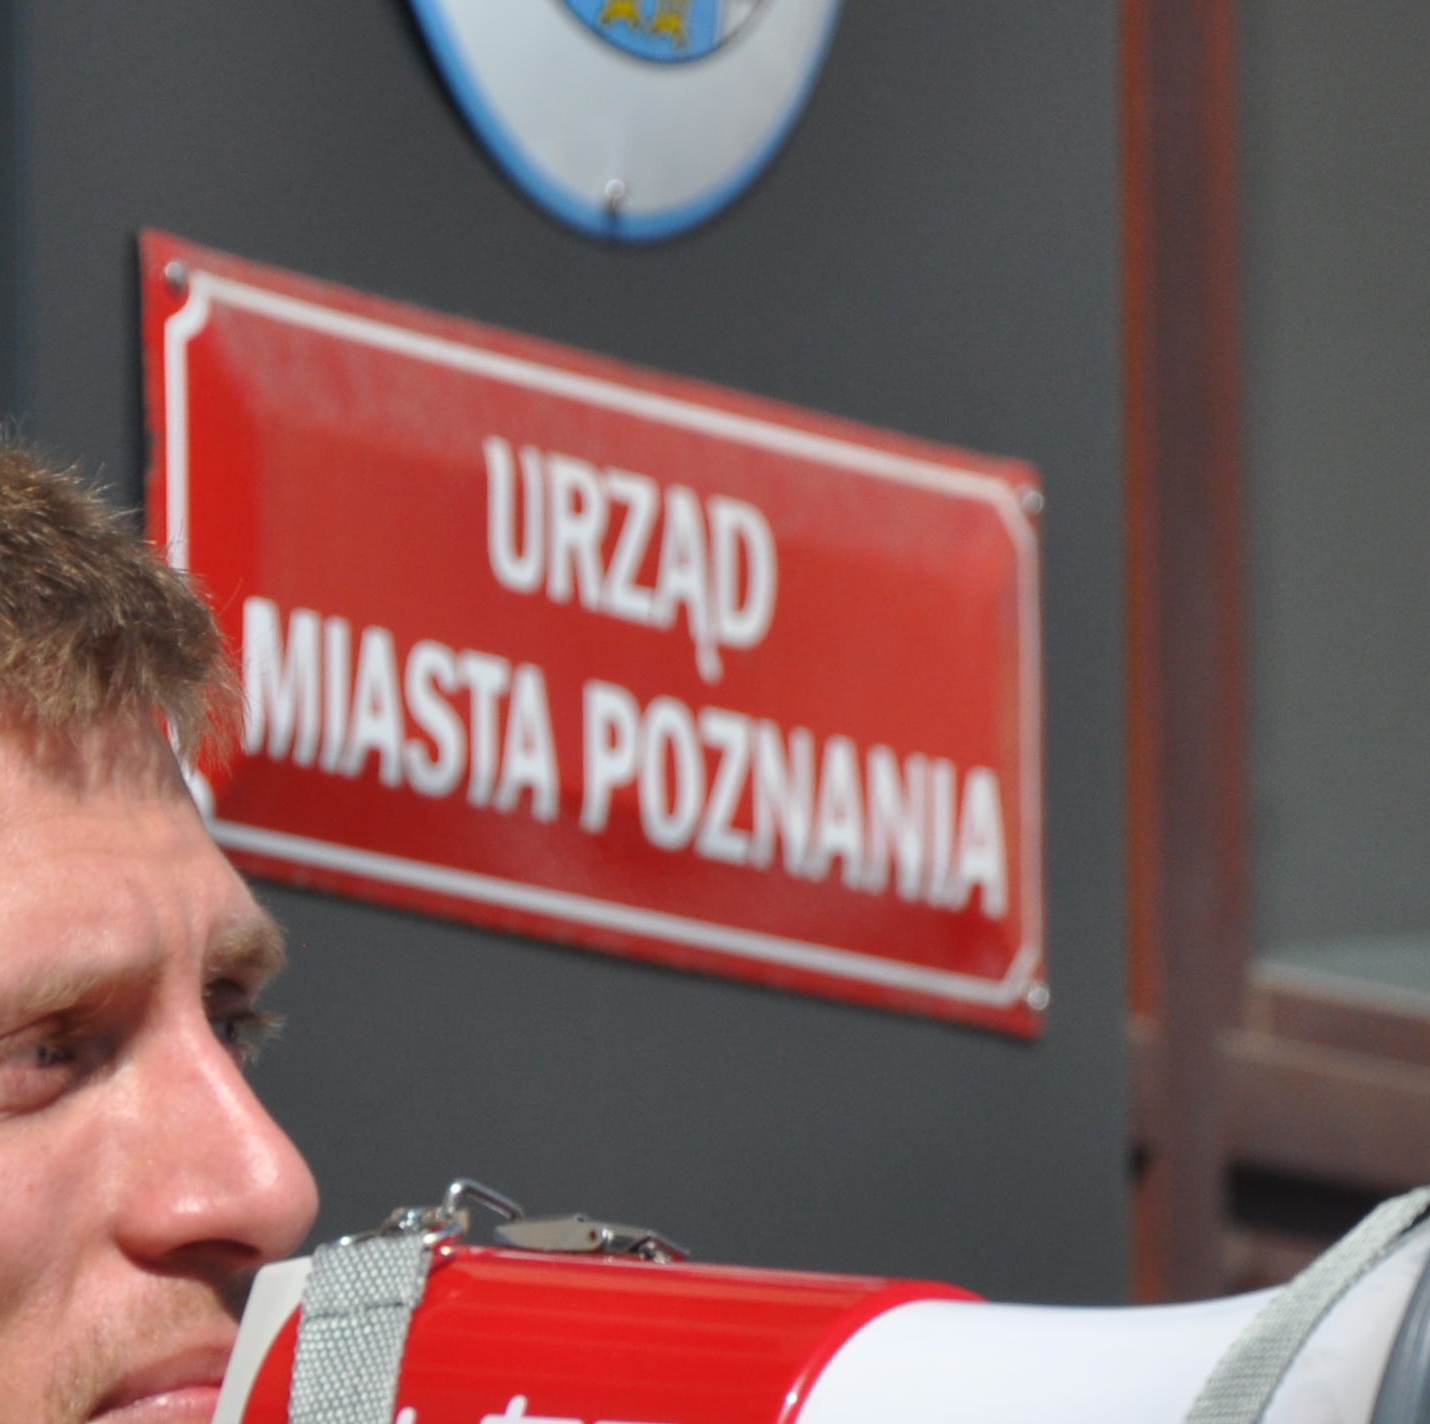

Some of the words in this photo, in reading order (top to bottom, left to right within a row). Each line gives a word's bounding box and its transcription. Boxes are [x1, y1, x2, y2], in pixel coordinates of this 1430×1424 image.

[481, 433, 777, 684] URZĄD
[242, 596, 559, 822] MIASTA
[580, 679, 1007, 918] POZNANIA
